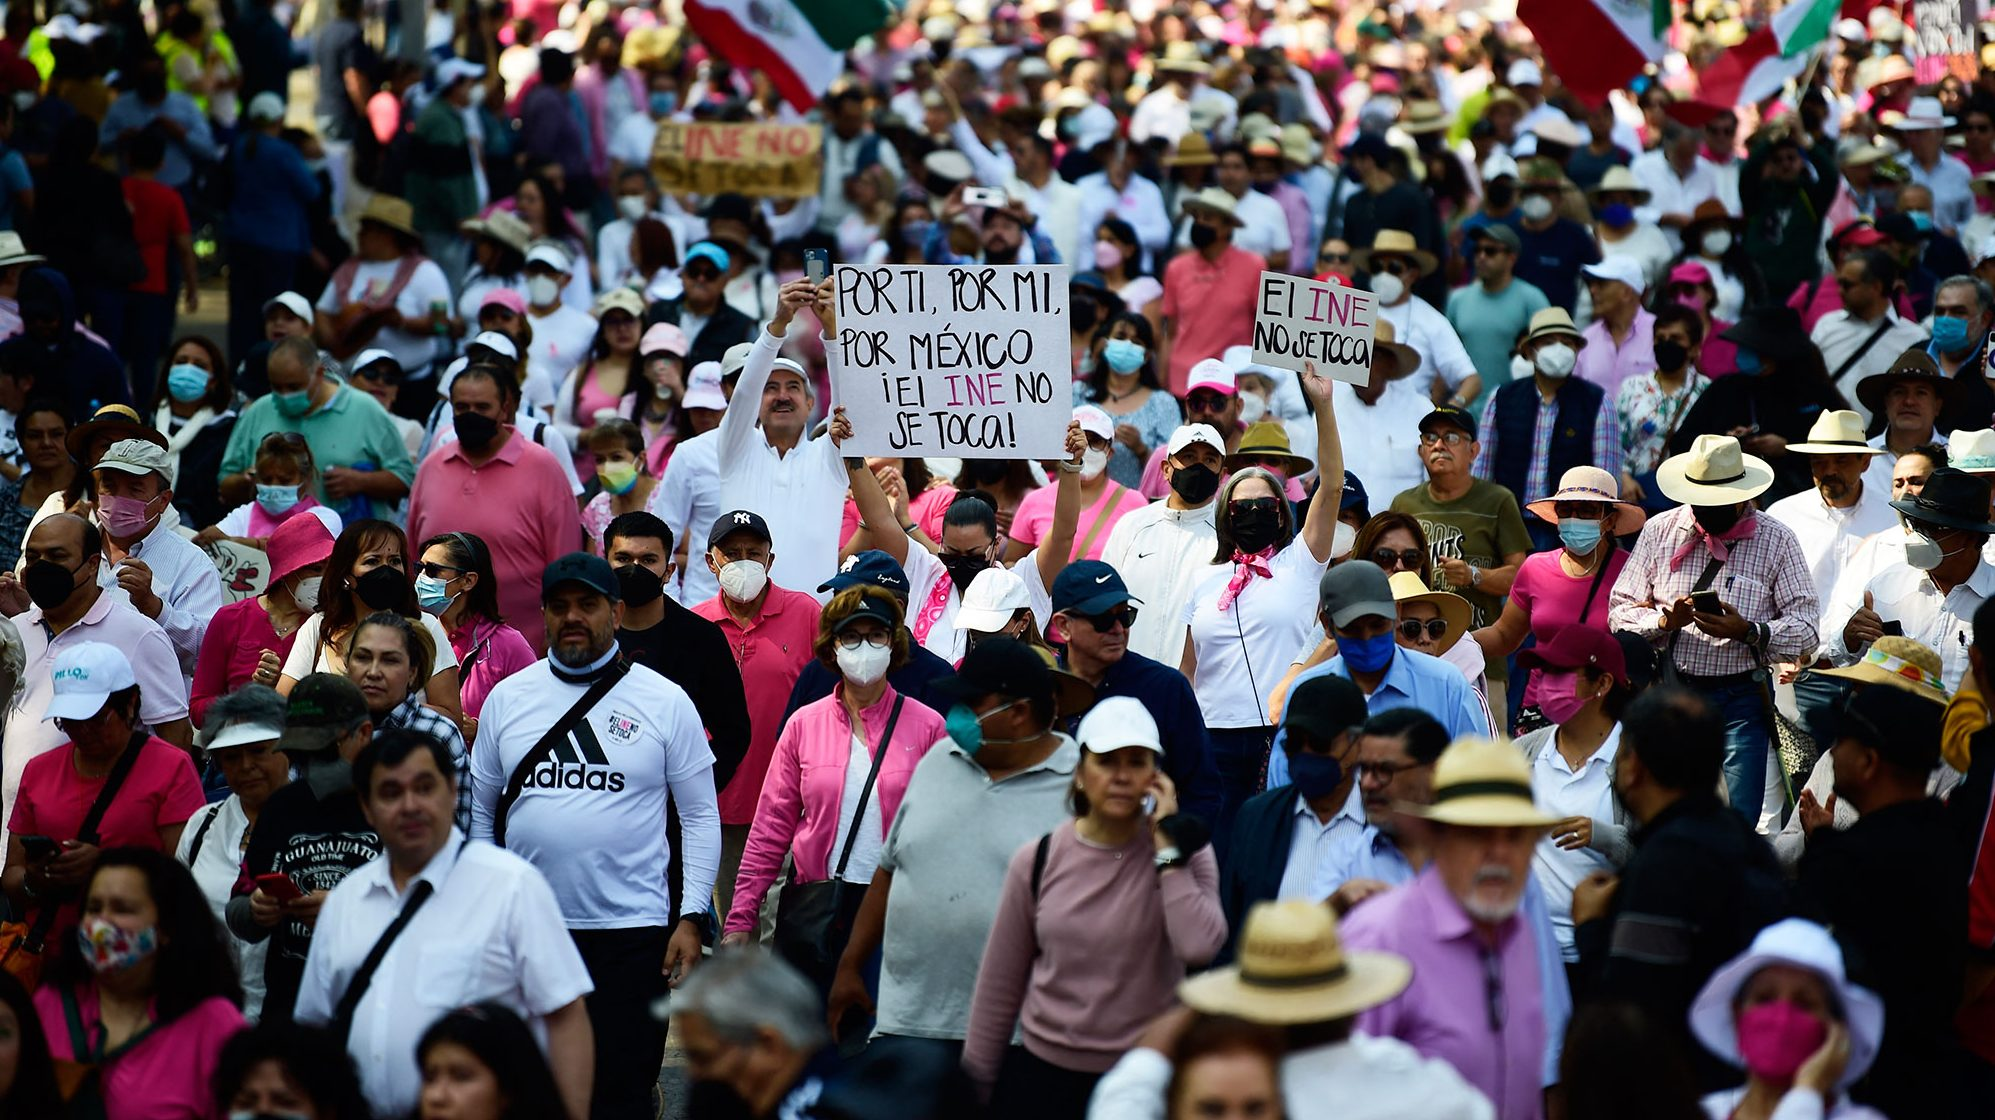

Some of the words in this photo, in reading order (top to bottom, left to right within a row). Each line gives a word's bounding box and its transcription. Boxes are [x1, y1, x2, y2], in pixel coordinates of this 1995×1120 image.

[684, 126, 745, 161] INE
[756, 126, 811, 158] NO
[838, 267, 898, 317] POR
[900, 269, 938, 316] TI,
[947, 267, 1007, 312] POR
[1013, 270, 1062, 315] MI,
[1304, 287, 1370, 327] INE
[840, 328, 897, 368] POR
[909, 322, 1034, 370] MÉXICO
[1254, 321, 1290, 354] NO
[1292, 330, 1318, 359] SE
[944, 372, 1007, 407] INE
[1015, 371, 1053, 404] NO
[889, 411, 923, 450] SE
[285, 841, 379, 863] GUANAJUATO
[313, 872, 341, 881] SINCE
